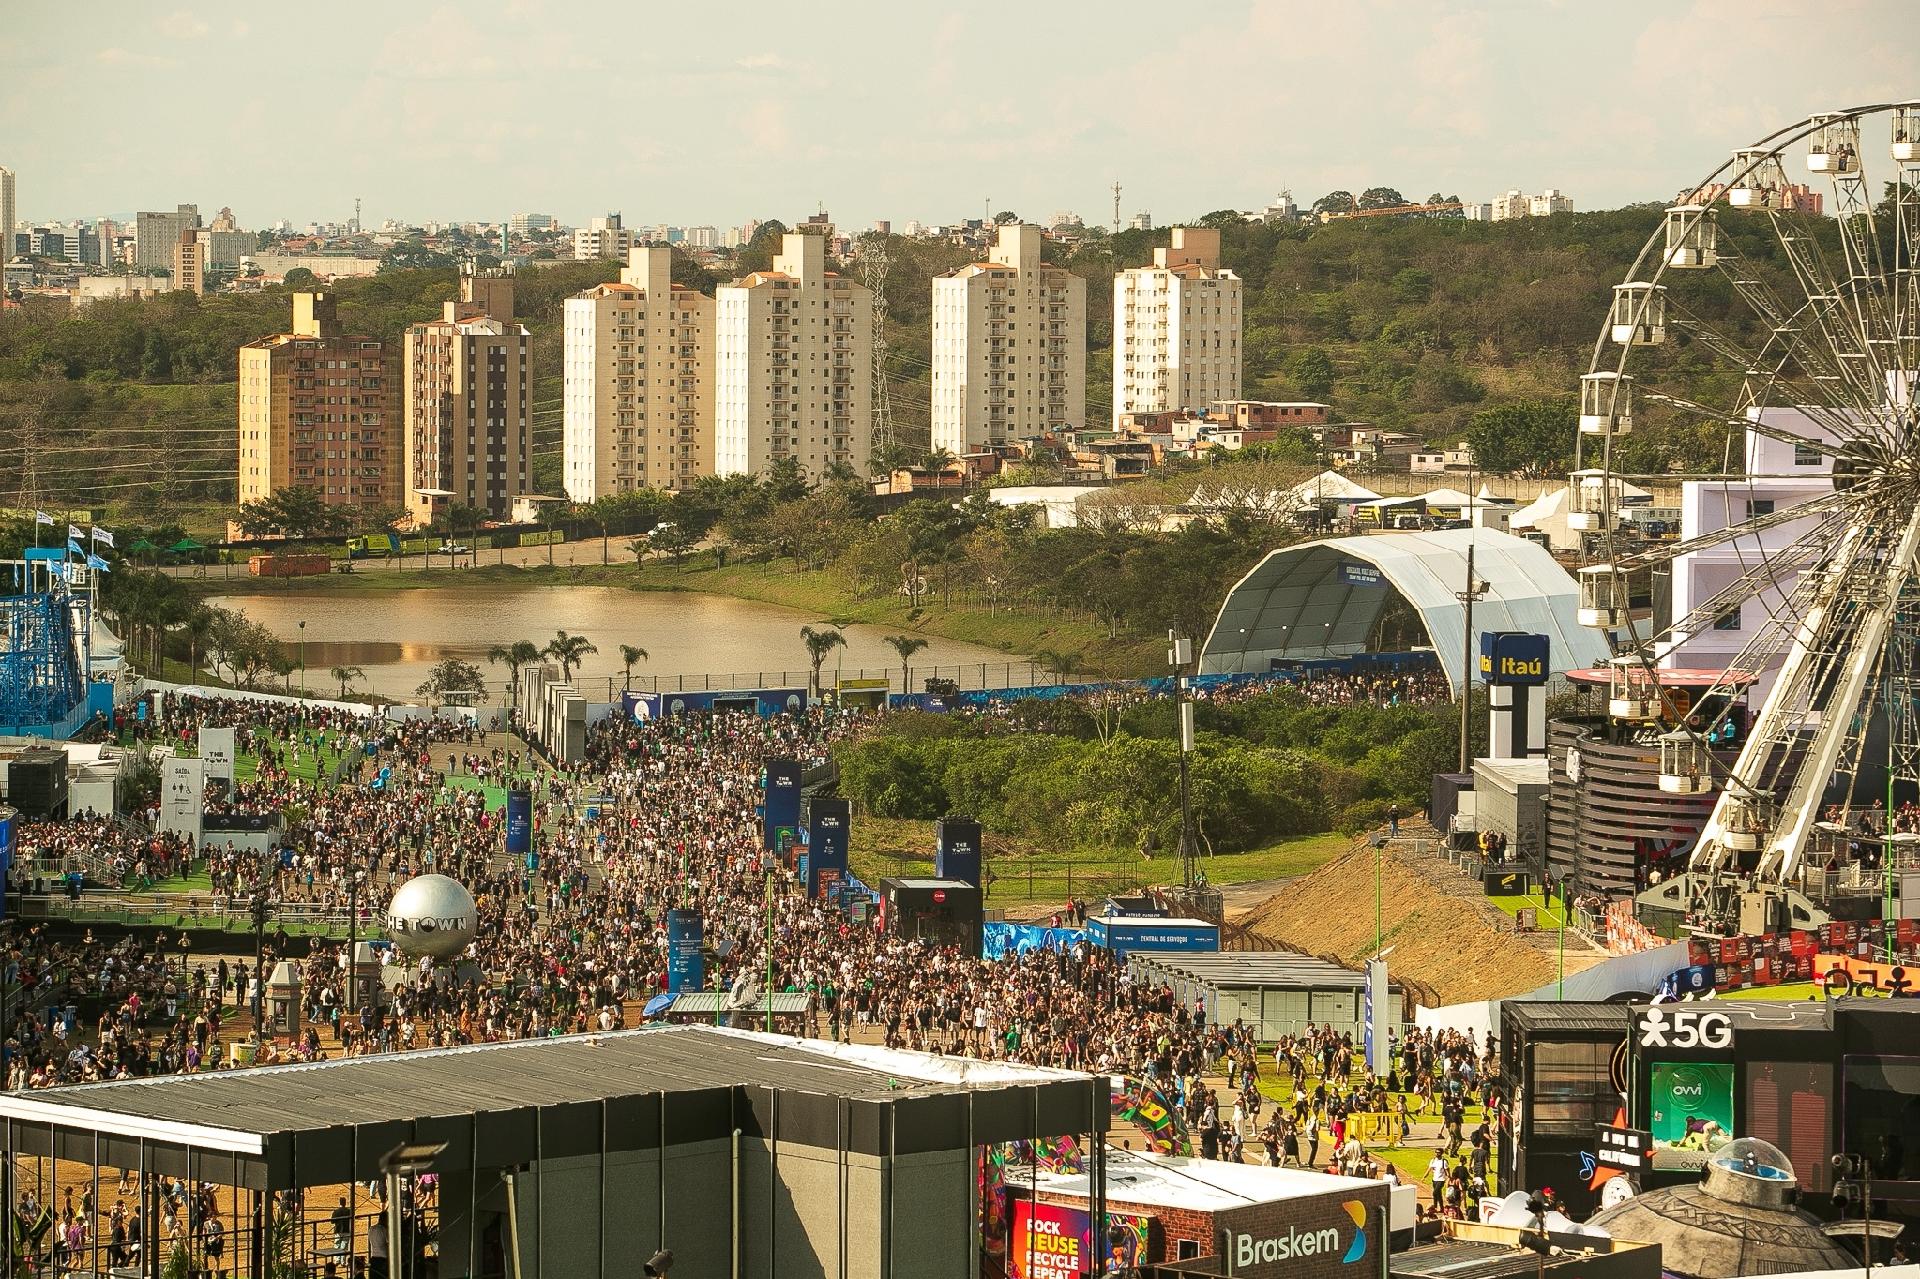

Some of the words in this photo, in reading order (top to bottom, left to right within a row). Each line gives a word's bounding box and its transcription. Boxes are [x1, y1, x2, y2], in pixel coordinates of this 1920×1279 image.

[1501, 657, 1542, 675] Itaú
[386, 916, 404, 931] HE
[408, 916, 467, 933] TOWN
[1671, 1012, 1732, 1049] 5G
[1026, 1218, 1060, 1235] ROCK
[1237, 1225, 1339, 1268] Braskem
